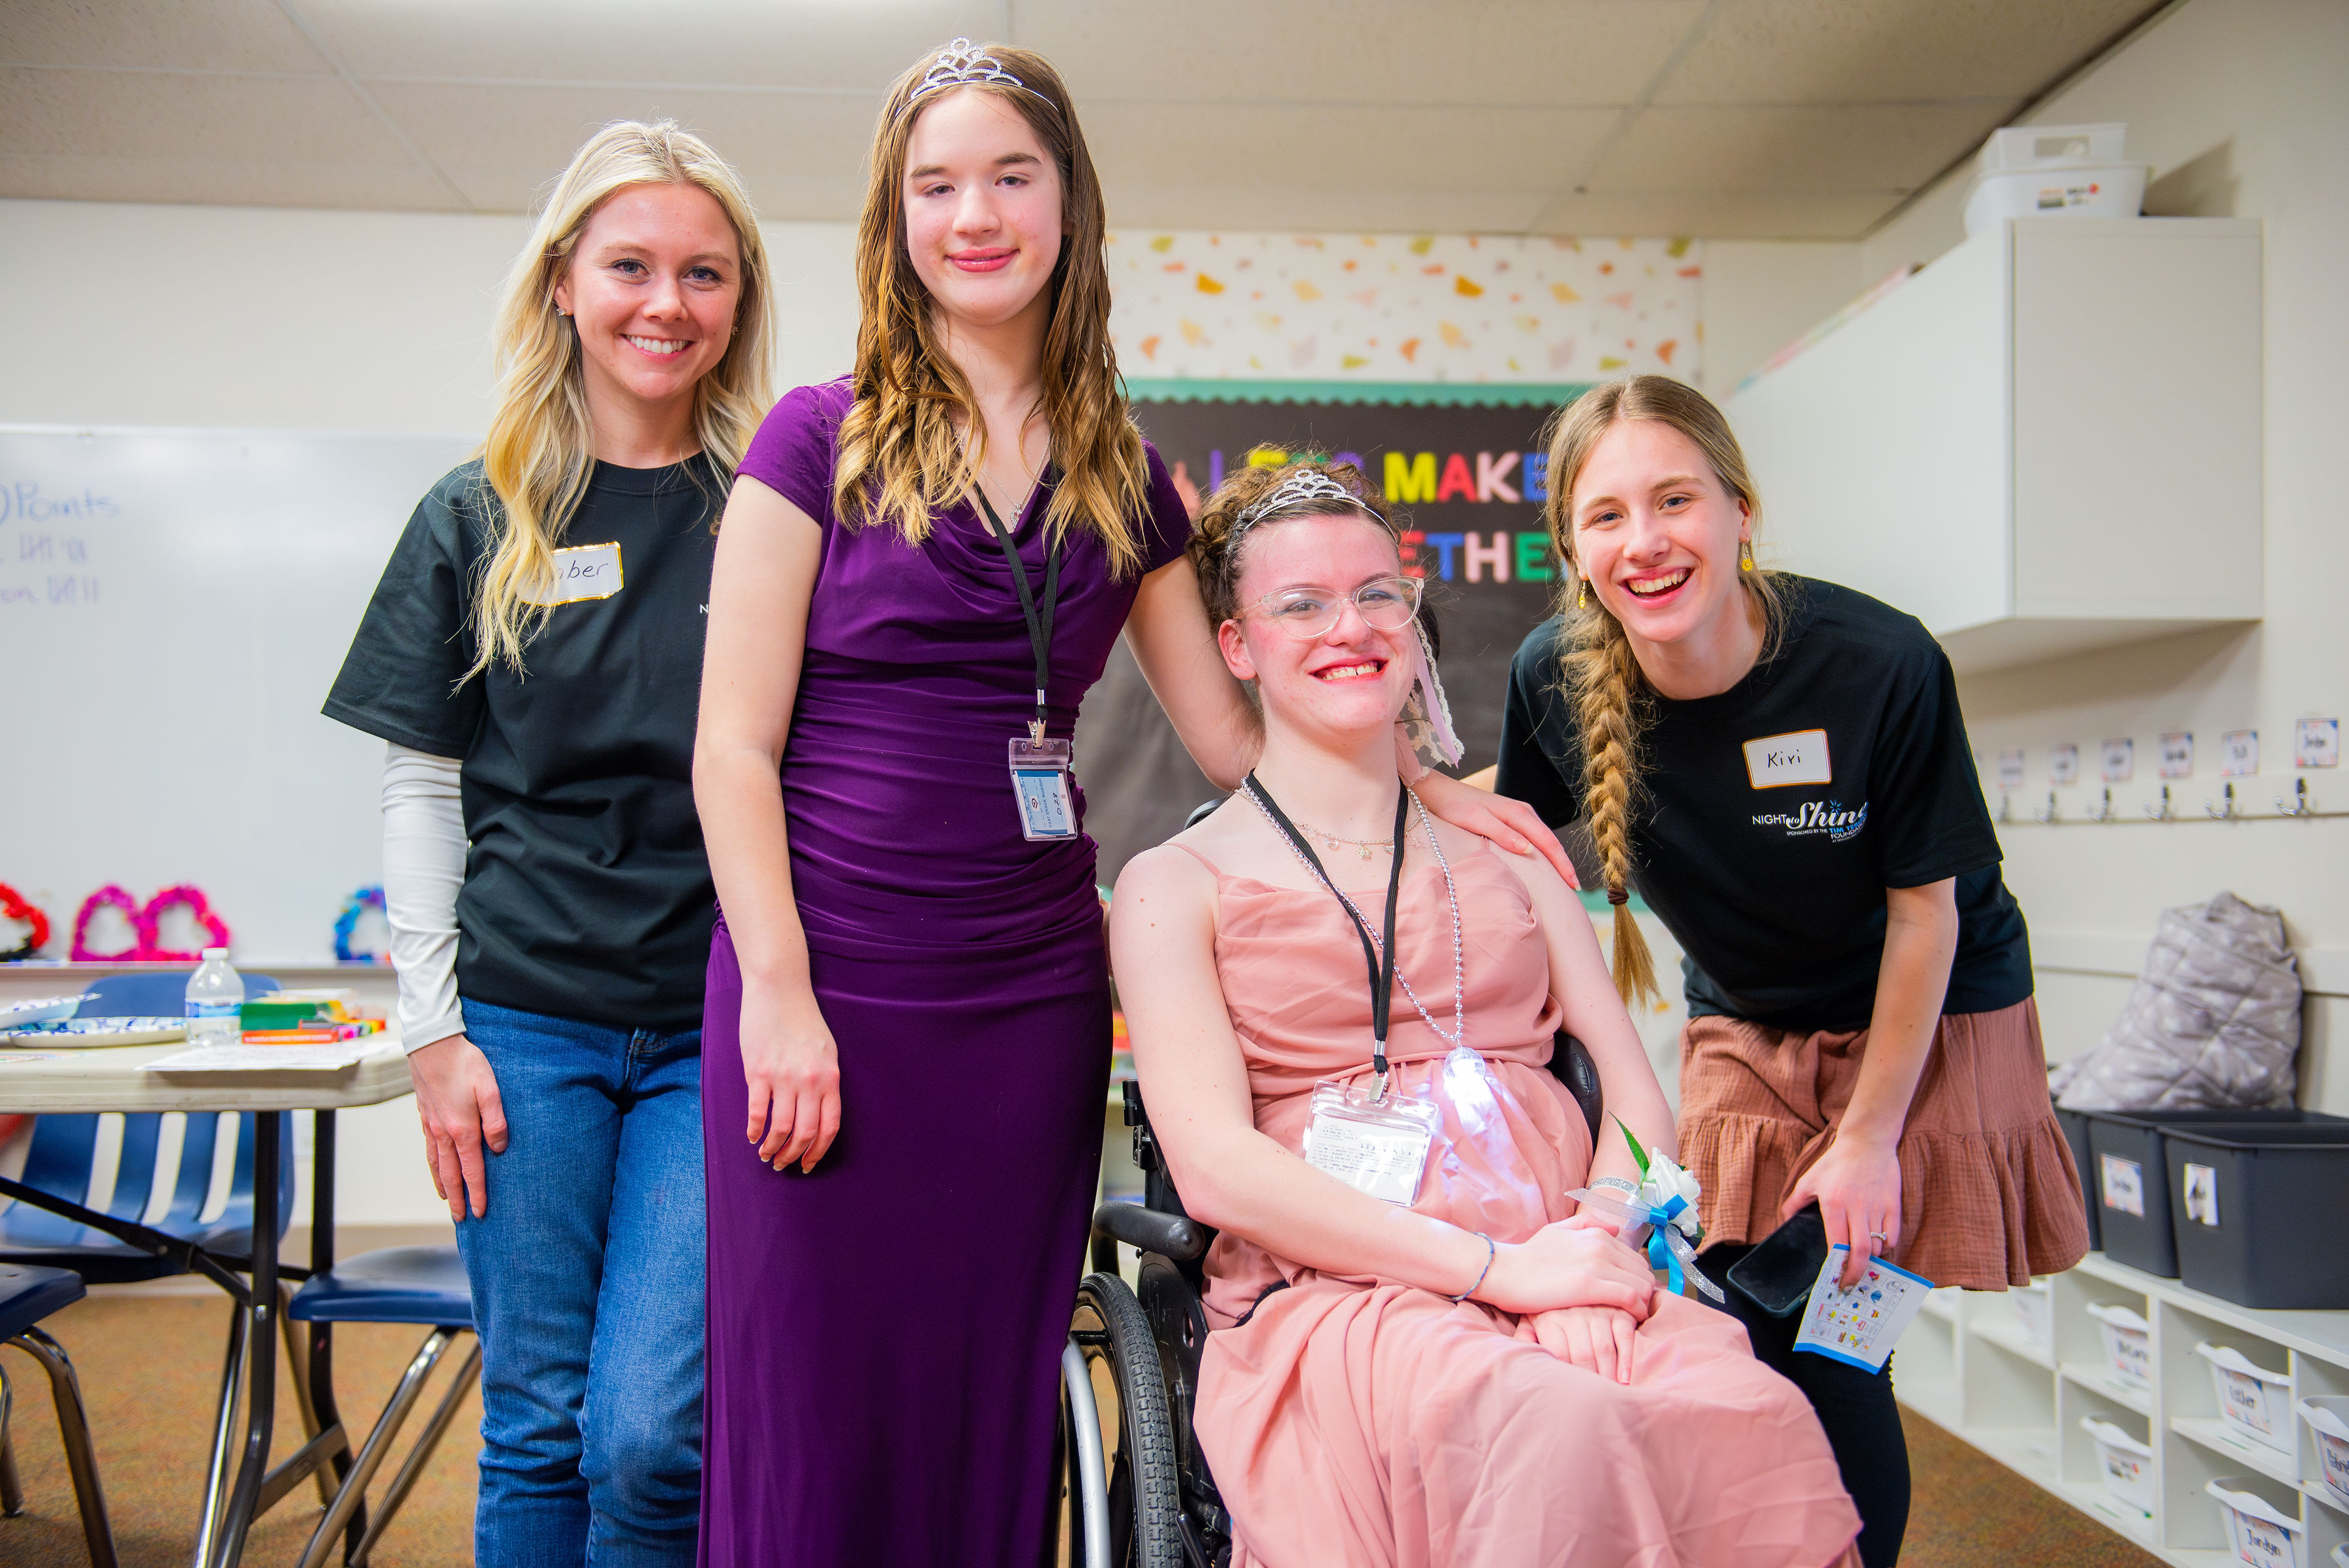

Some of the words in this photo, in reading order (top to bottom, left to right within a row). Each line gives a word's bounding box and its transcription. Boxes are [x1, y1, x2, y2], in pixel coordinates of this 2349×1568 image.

[1384, 451, 1549, 503] MAKE
[1767, 749, 1801, 768] Kiri
[1752, 814, 1787, 825] NIGHT
